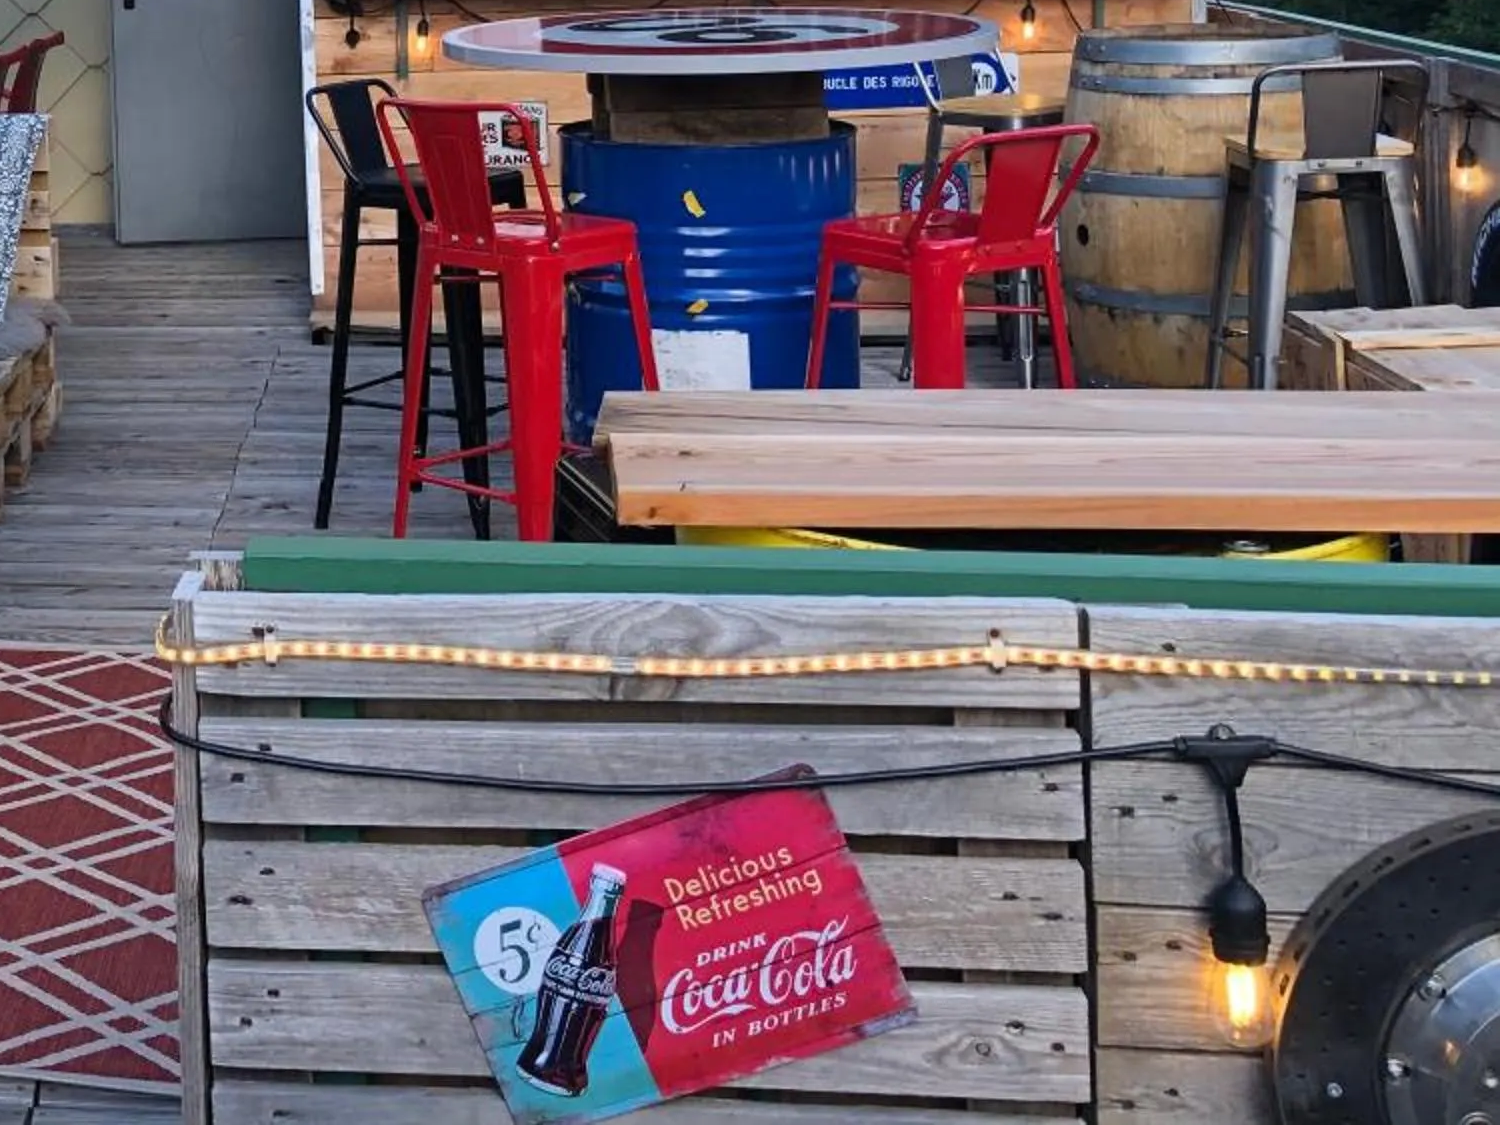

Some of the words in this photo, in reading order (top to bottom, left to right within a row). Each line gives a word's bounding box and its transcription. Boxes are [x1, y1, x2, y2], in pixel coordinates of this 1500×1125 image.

[863, 76, 886, 89] DES
[891, 75, 935, 88] RIGOE
[663, 846, 793, 903] Delicious
[677, 868, 823, 931] Refreshing
[697, 933, 767, 966] DRINK
[713, 1028, 735, 1049] IN
[748, 992, 849, 1038] BOTTLES
